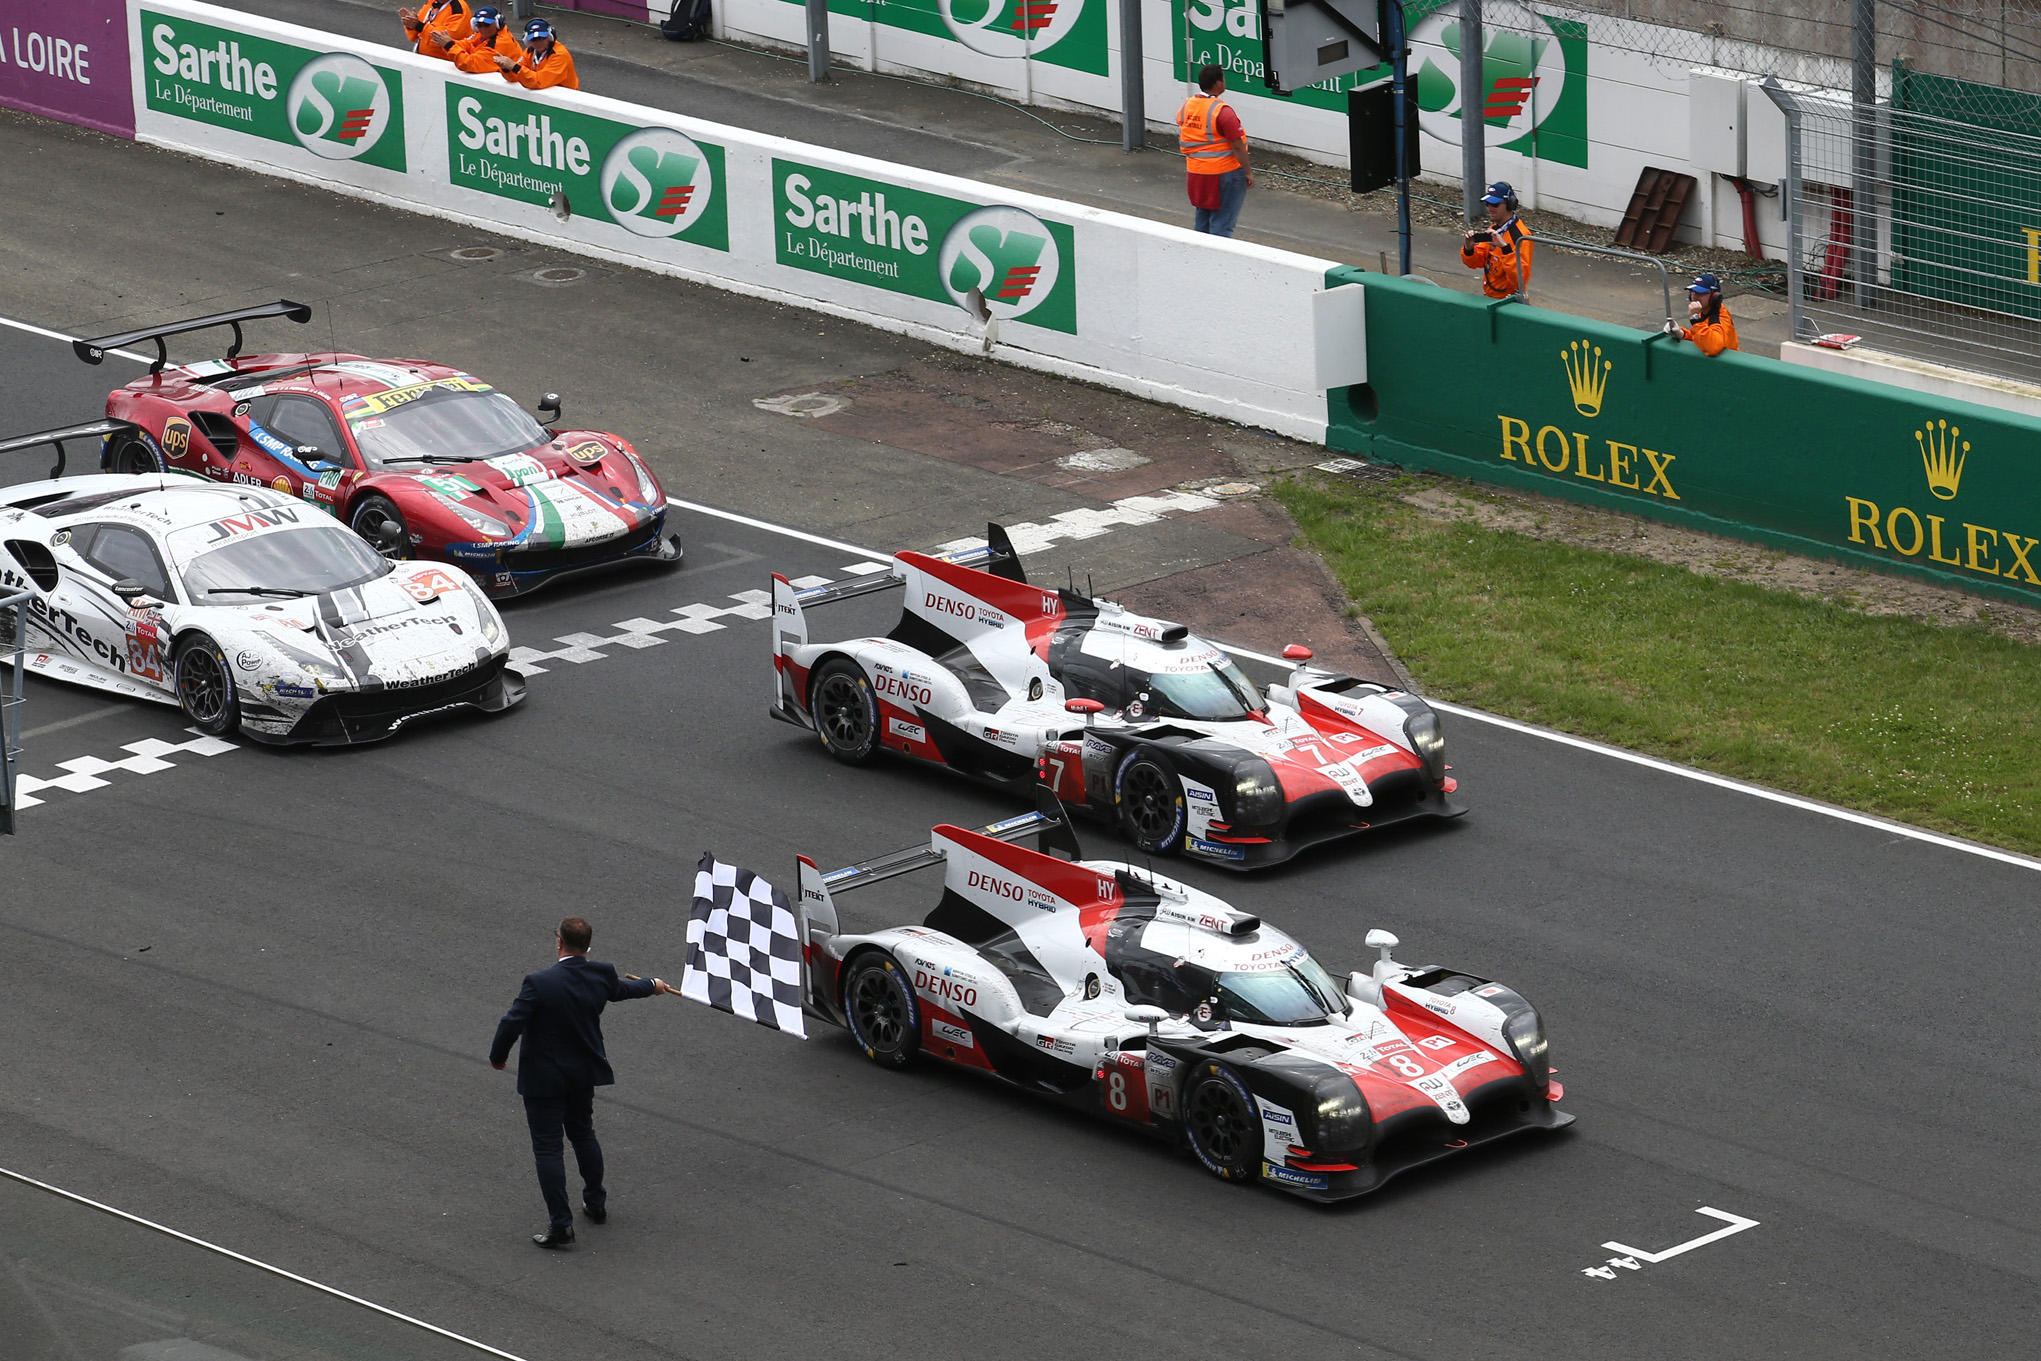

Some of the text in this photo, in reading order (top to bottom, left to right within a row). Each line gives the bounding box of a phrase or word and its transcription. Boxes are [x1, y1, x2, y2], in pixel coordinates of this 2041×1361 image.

[13, 27, 91, 85] LOIRE
[1184, 38, 1211, 66] Le
[152, 23, 278, 100] Sarthe
[155, 79, 253, 121] Le Département
[457, 96, 591, 176] Sarthe
[459, 153, 563, 196] Le Département
[785, 173, 929, 255] Sarthe
[786, 231, 899, 278] Le Département
[166, 428, 187, 452] ups
[574, 446, 605, 459] ups
[1498, 414, 1680, 500] ROLEX
[233, 472, 262, 488] ADLER
[314, 490, 334, 502] TOTAL
[206, 508, 300, 544] JMW
[1845, 495, 2041, 586] ROLEX
[407, 574, 456, 600] 84
[777, 604, 796, 615] JTEKT
[925, 592, 975, 620] DENSO
[978, 607, 1005, 621] TOYOTA
[1042, 596, 1058, 615] HY
[136, 626, 155, 639] TOTAL
[324, 614, 457, 651] WeatherTech
[978, 617, 1005, 630] HYBRID
[1133, 623, 1159, 639] ZENT
[129, 638, 161, 679] 84
[1180, 650, 1217, 664] DENSO
[385, 662, 476, 690] WeatherTech
[1165, 665, 1209, 673] TOYOTA
[875, 673, 932, 705] DENSO
[1357, 707, 1364, 716] 7
[898, 723, 921, 735] WEC
[983, 730, 999, 741] GR
[1086, 739, 1113, 753] RAYS
[1298, 744, 1328, 764] 7
[1049, 759, 1064, 792] 7
[1188, 789, 1211, 800] AISIN
[1199, 844, 1239, 856] MICHELIN
[804, 889, 825, 902] JTEKT
[967, 871, 1024, 902] DENSO
[1097, 879, 1115, 900] HY
[1027, 889, 1056, 904] TOYOTA
[1027, 900, 1057, 914] HYBRID
[1199, 914, 1228, 932] ZENT
[1251, 943, 1294, 962] DENSO
[1234, 962, 1286, 971] TOYOTA
[914, 970, 977, 1006] DENSO
[1449, 1005, 1457, 1015] 8
[942, 1025, 967, 1040] WEC
[1037, 1039, 1053, 1050] GR
[1377, 1042, 1407, 1053] TOTAL
[1425, 1037, 1449, 1048] P1
[1146, 1051, 1176, 1069] RAYS
[1388, 1054, 1424, 1077] 8
[1456, 1053, 1484, 1067] WEC
[1109, 1071, 1127, 1111] 8
[1155, 1087, 1171, 1109] P1
[1264, 1111, 1290, 1124] AISIN
[1278, 1171, 1321, 1185] MICHELIN
[1580, 1256, 1642, 1280] 44
